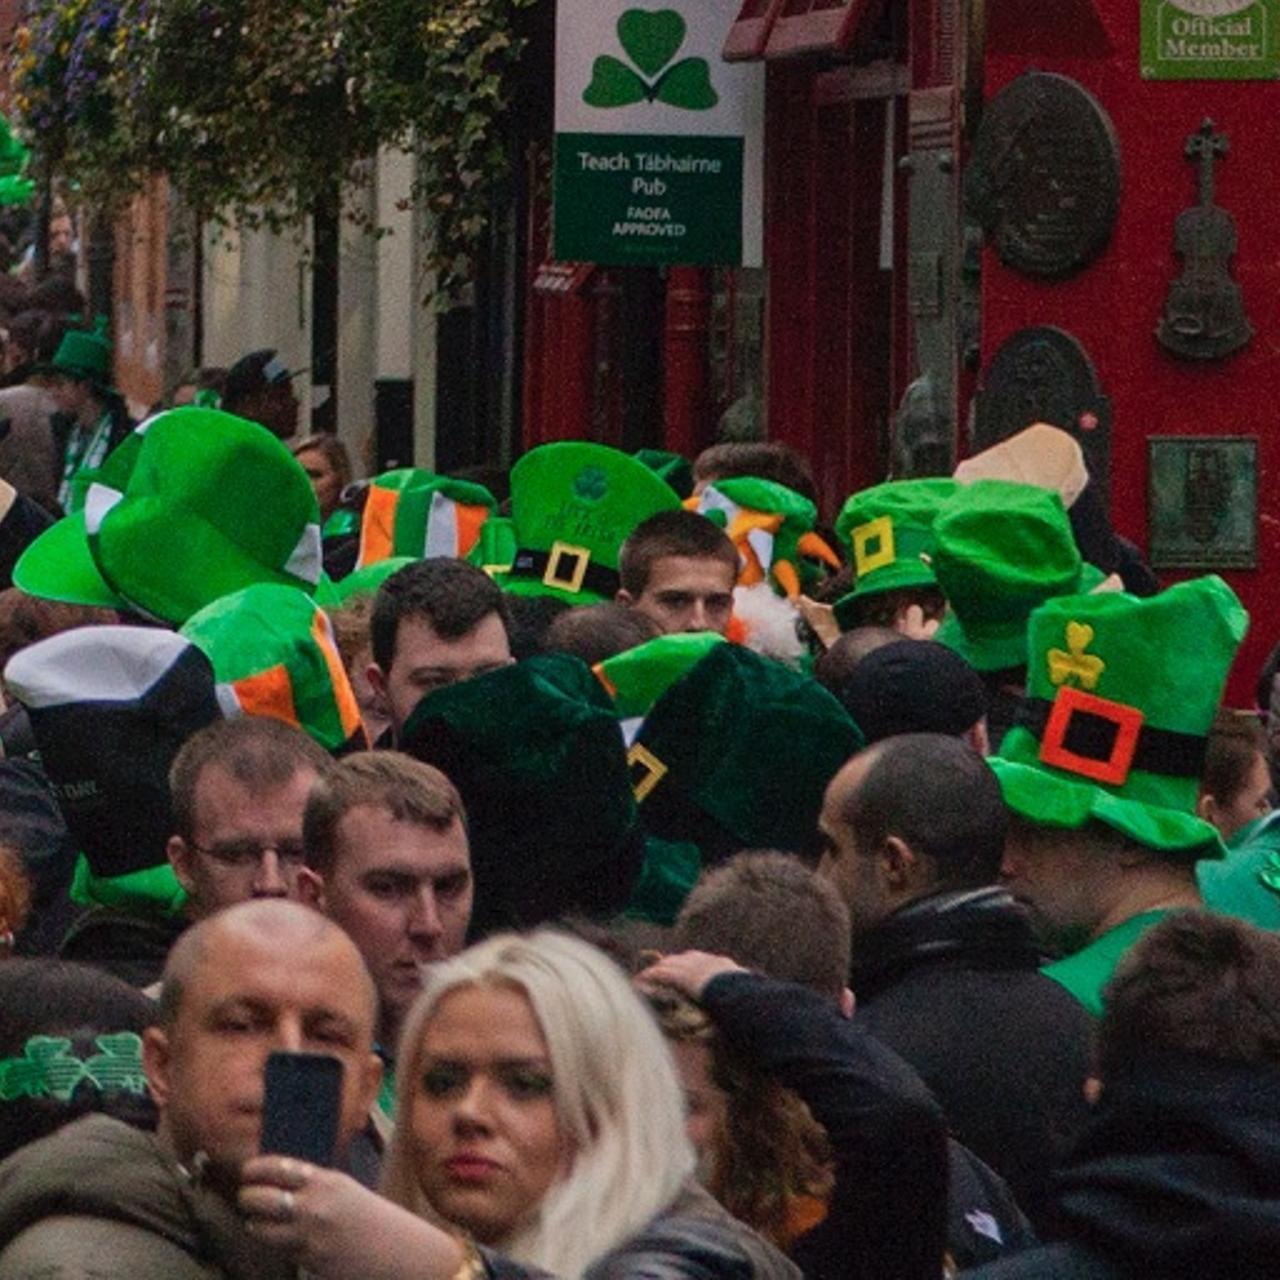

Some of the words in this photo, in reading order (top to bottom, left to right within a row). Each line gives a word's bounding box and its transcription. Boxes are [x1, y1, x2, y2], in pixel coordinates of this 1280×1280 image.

[1171, 17, 1252, 37] Official
[1165, 38, 1260, 57] Member
[577, 151, 630, 172] Teach
[634, 151, 722, 173] Tábhairne
[631, 176, 668, 196] Pub
[611, 223, 687, 237] APPROVED
